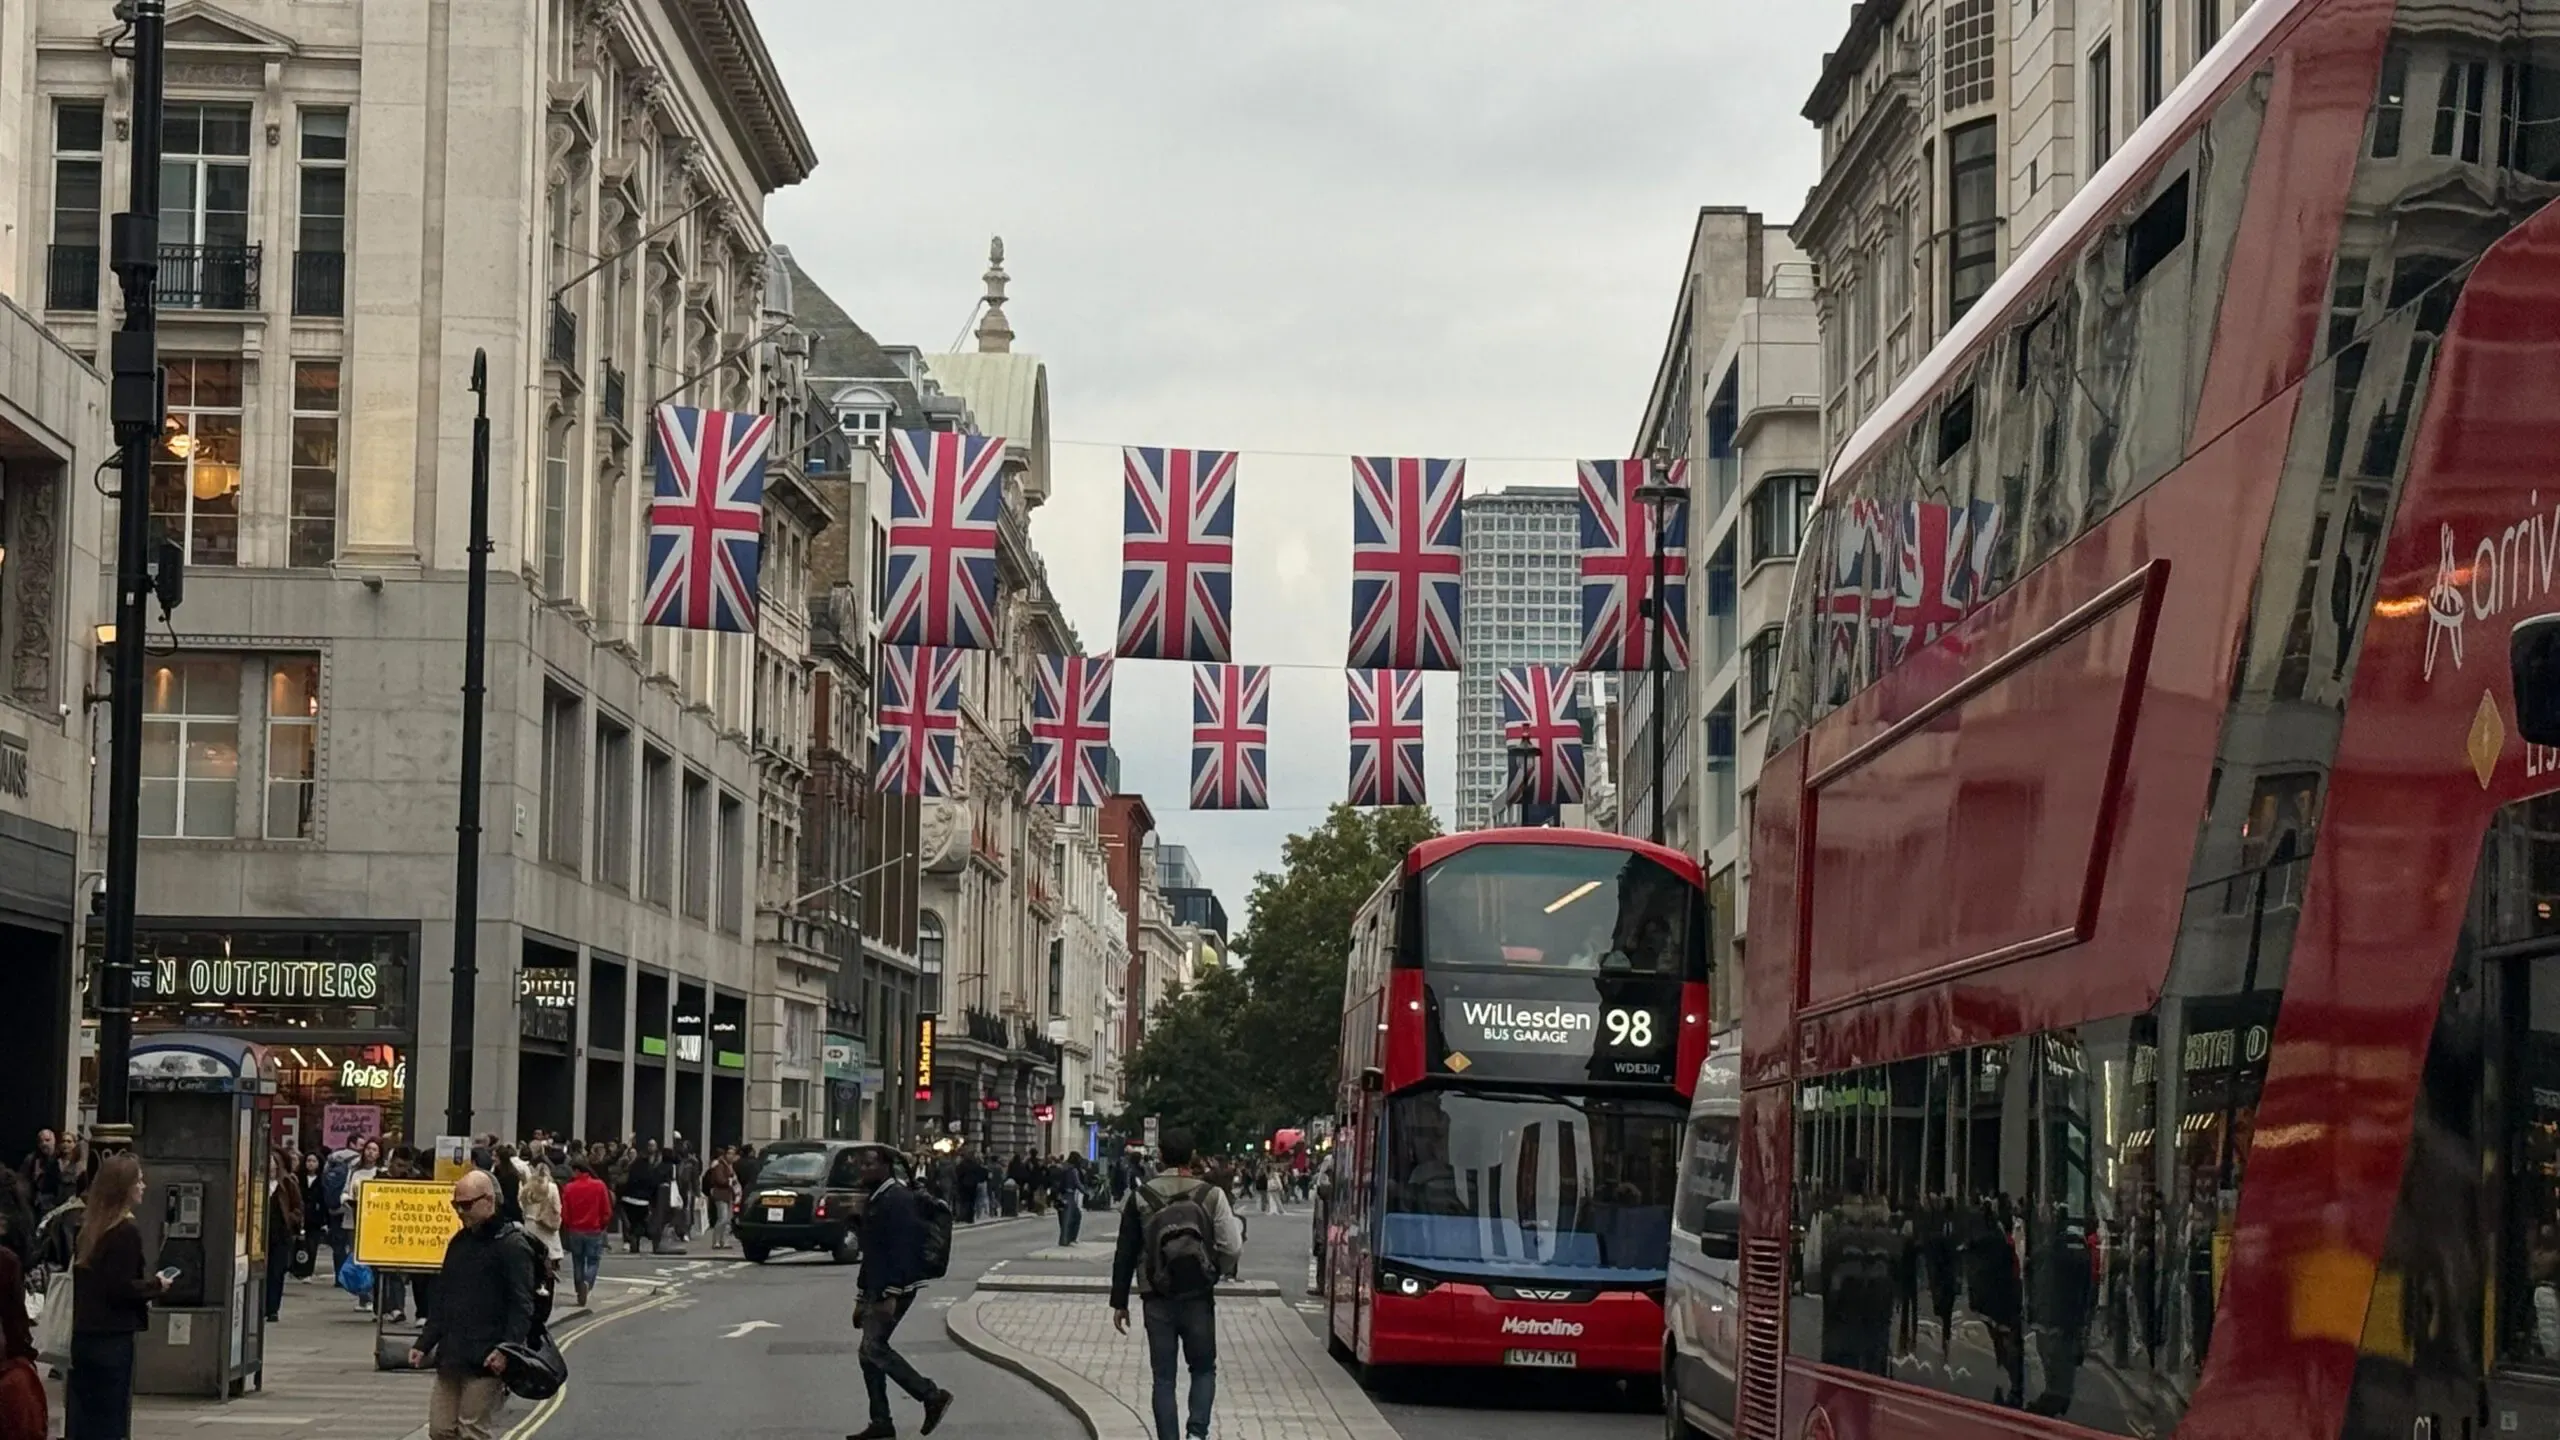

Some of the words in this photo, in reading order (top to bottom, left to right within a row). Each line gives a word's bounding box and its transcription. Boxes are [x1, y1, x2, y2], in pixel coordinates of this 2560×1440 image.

[189, 960, 377, 999] OUTFITTERS
[1462, 1001, 1592, 1031] Willesden
[1606, 1008, 1652, 1048] 98
[1484, 1027, 1510, 1042] BUS
[1513, 1029, 1569, 1044] GARAGE
[366, 1201, 391, 1210] THIS
[395, 1202, 424, 1213] ROAD
[390, 1212, 432, 1222] CLOSED
[435, 1213, 453, 1223] ON
[383, 1236, 404, 1246] FOR
[1501, 1315, 1584, 1337] Metroline
